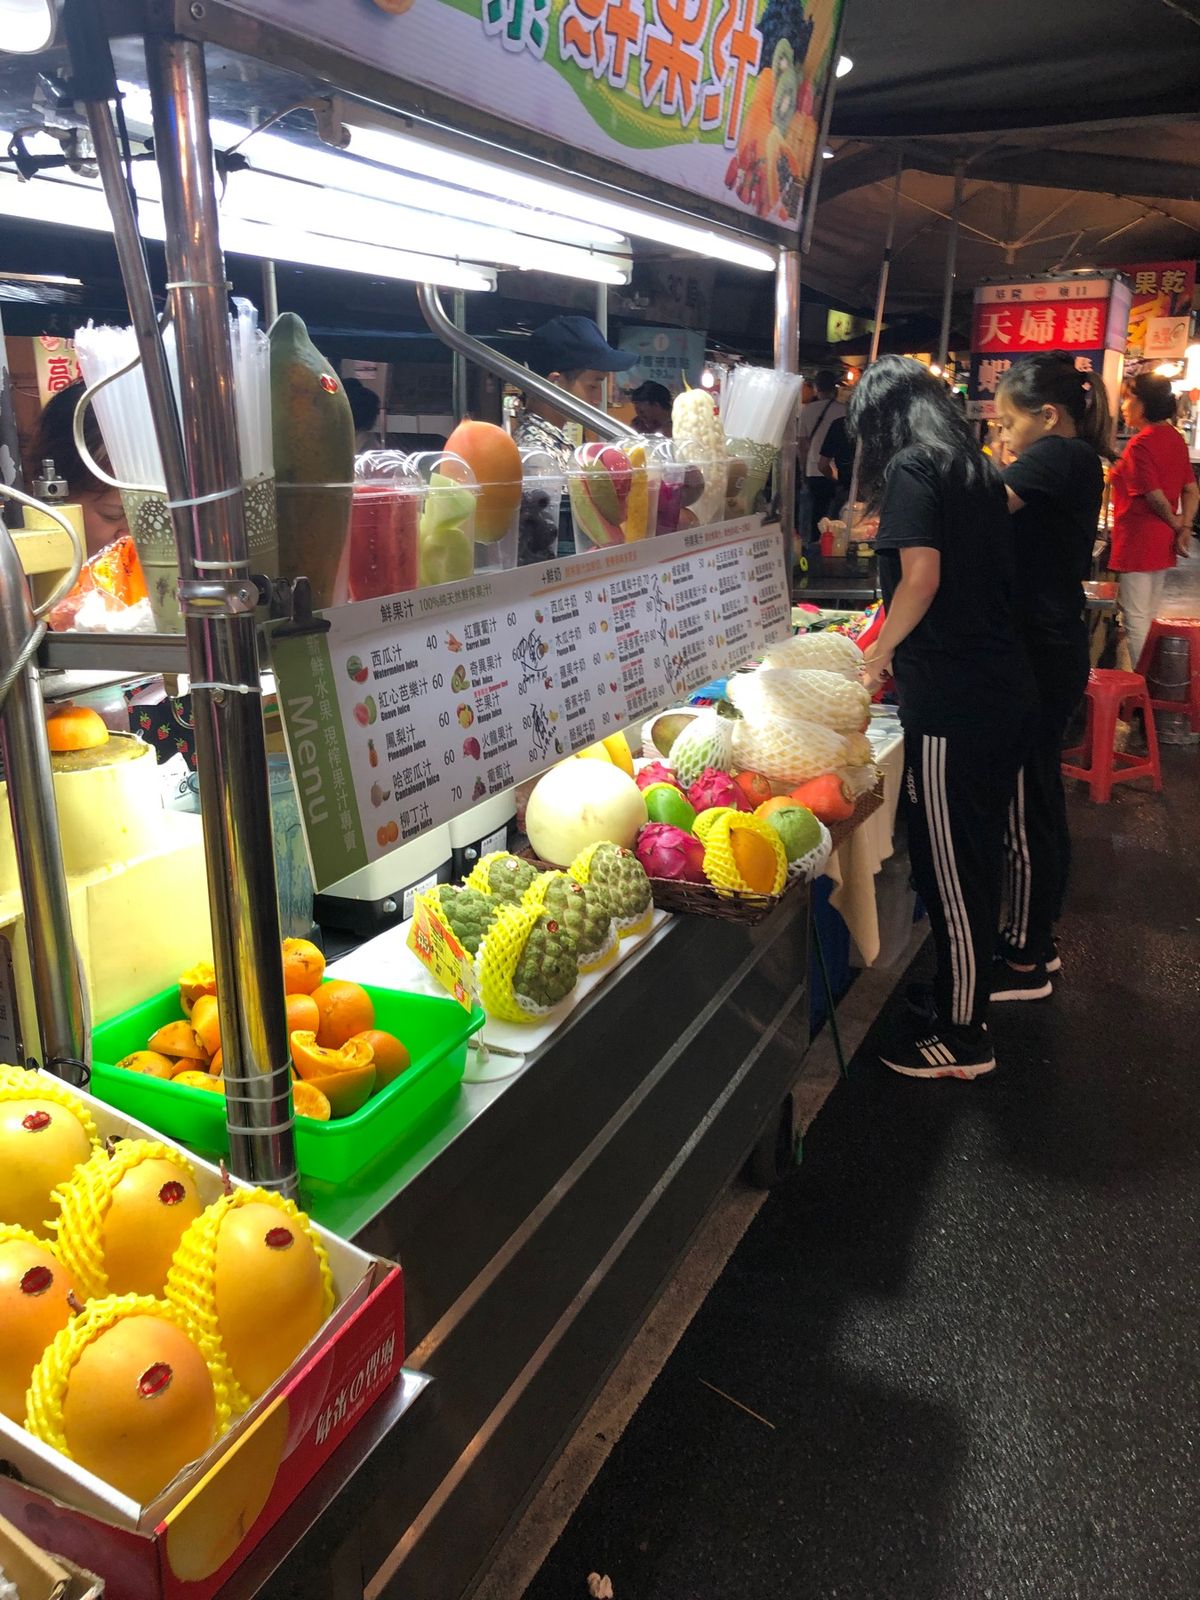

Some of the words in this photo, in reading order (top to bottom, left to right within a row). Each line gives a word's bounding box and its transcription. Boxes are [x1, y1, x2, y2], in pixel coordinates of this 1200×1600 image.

[979, 306, 1101, 345] 天婦羅
[380, 599, 414, 623] 鮮果汁
[550, 594, 577, 614] 西瓜牛奶
[585, 590, 592, 603] 50
[506, 612, 517, 626] 60
[479, 637, 490, 647] Juice
[555, 627, 581, 646] 木瓜牛奶
[589, 622, 596, 635] 60
[370, 644, 402, 668] 西瓜汁
[426, 634, 437, 650] 40
[470, 652, 502, 676] 奇異果汁
[512, 645, 522, 661] 60
[593, 652, 600, 665] 60
[373, 663, 405, 680] Watermelon
[405, 659, 418, 670] Juice
[482, 674, 493, 684] Juice
[378, 677, 428, 709] 紅心芭樂汁
[432, 673, 443, 689] 60
[475, 691, 500, 713] 芒果汁
[518, 679, 527, 695] 80
[565, 689, 591, 711] 香蕉牛奶
[598, 683, 605, 696] 60
[397, 704, 410, 715] Juice
[438, 711, 450, 727] 60
[482, 722, 513, 749] 火龍果汁
[522, 715, 531, 730] 80
[288, 694, 330, 826] Menu
[388, 745, 413, 762] Pineapple
[413, 739, 426, 751] Juice
[392, 758, 431, 789] 哈密瓜汁
[444, 749, 455, 766] 60
[487, 761, 511, 784] 葡萄汁
[529, 748, 538, 762] 80
[395, 780, 426, 801] Cantaloupe
[426, 774, 440, 787] Juice
[489, 782, 502, 794] Grape
[502, 776, 514, 787] Juice
[399, 801, 429, 829] 柳丁汁
[451, 785, 462, 802] 70
[402, 824, 420, 839] Orange
[420, 817, 432, 829] Juice
